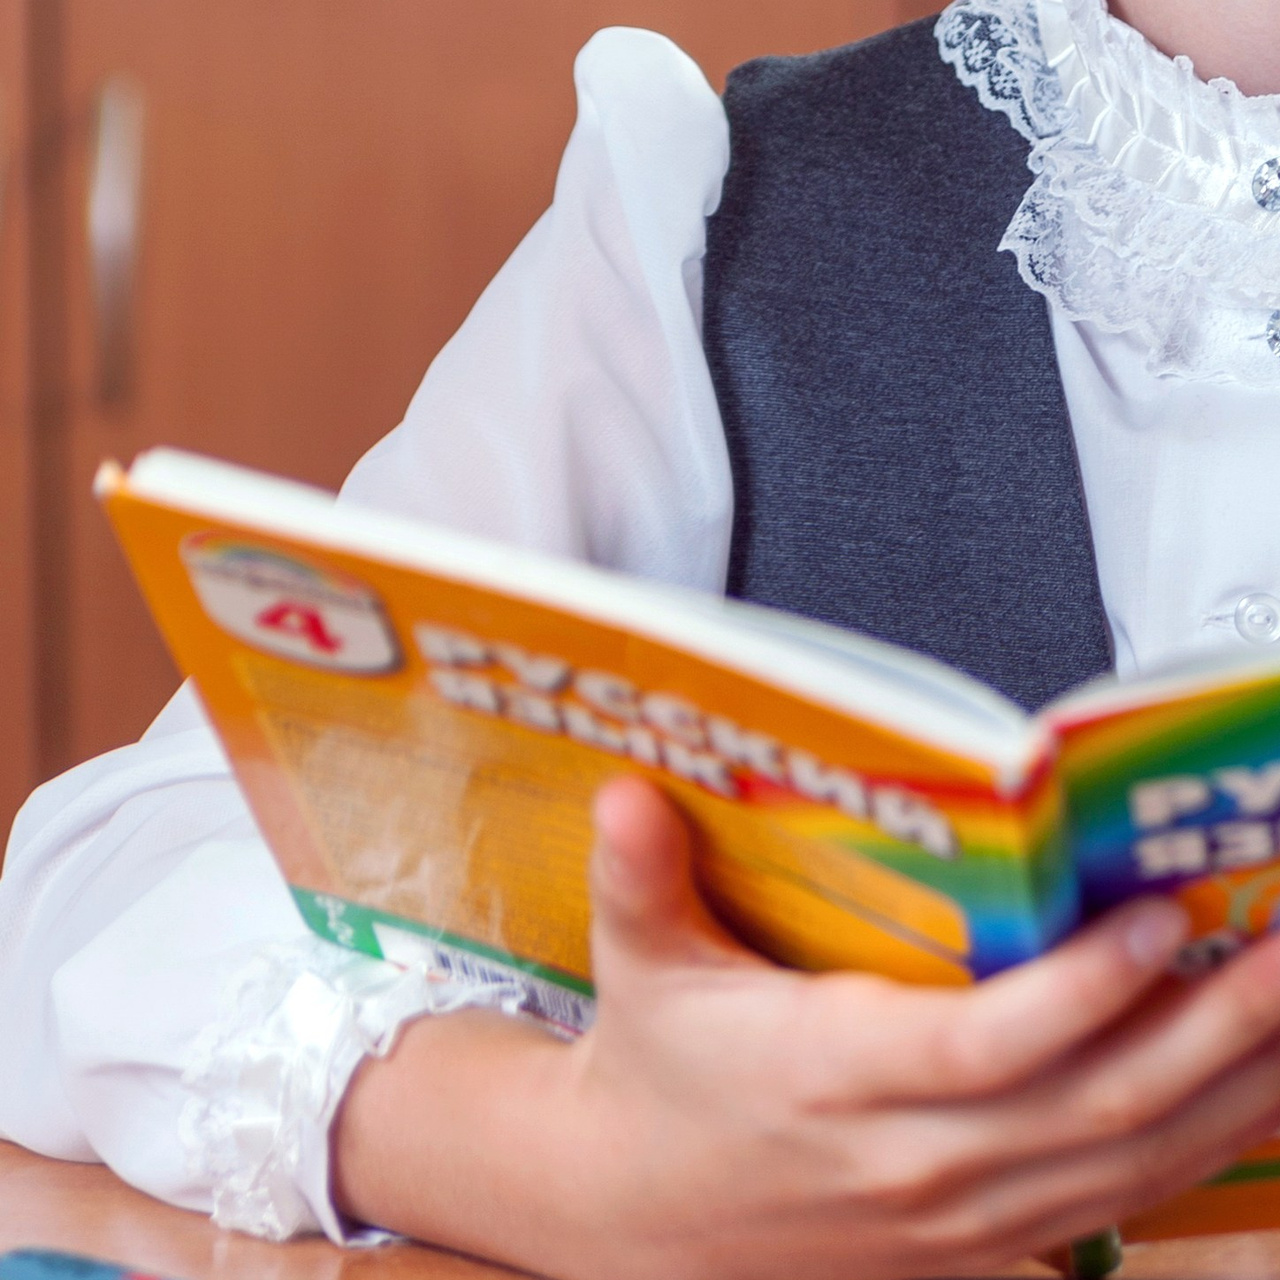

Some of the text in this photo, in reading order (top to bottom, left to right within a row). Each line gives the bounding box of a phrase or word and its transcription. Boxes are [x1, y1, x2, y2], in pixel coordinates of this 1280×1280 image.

[256, 597, 343, 654] 4
[411, 622, 961, 862] РУССКИЙ
[427, 666, 738, 800] ЯЗЫК
